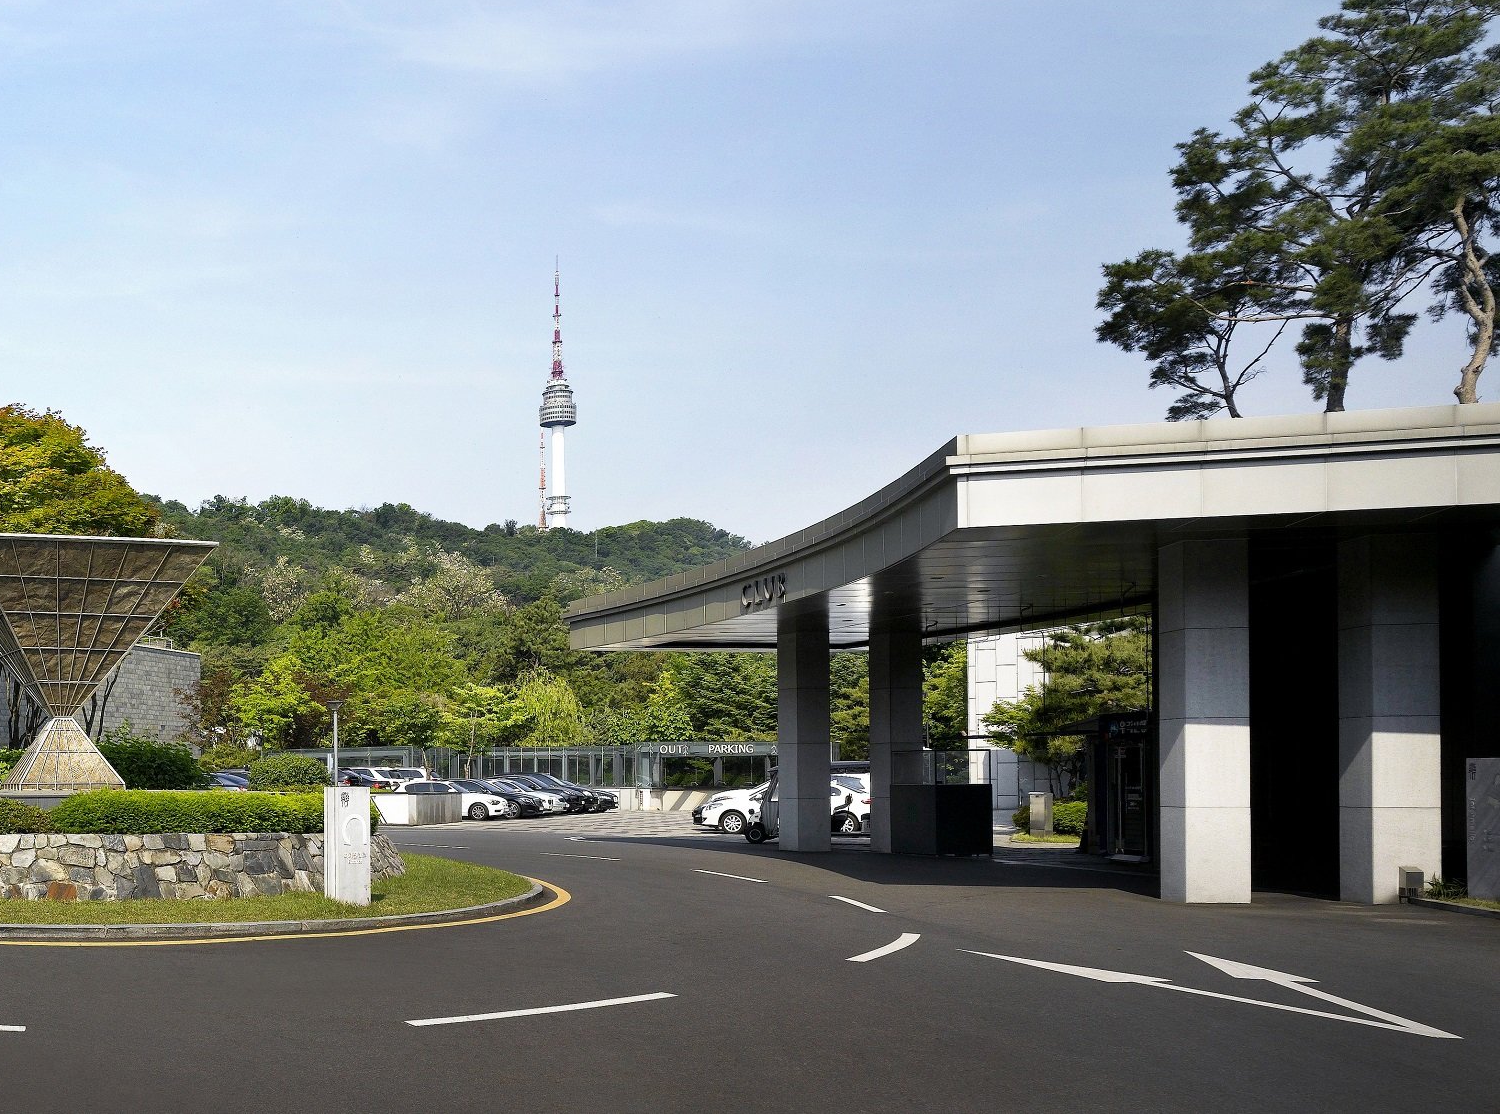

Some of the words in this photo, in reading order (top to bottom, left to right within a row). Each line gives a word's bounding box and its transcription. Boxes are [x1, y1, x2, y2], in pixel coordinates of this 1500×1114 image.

[741, 573, 786, 608] CLUB
[660, 744, 683, 754] OUT
[708, 744, 754, 754] PARKING
